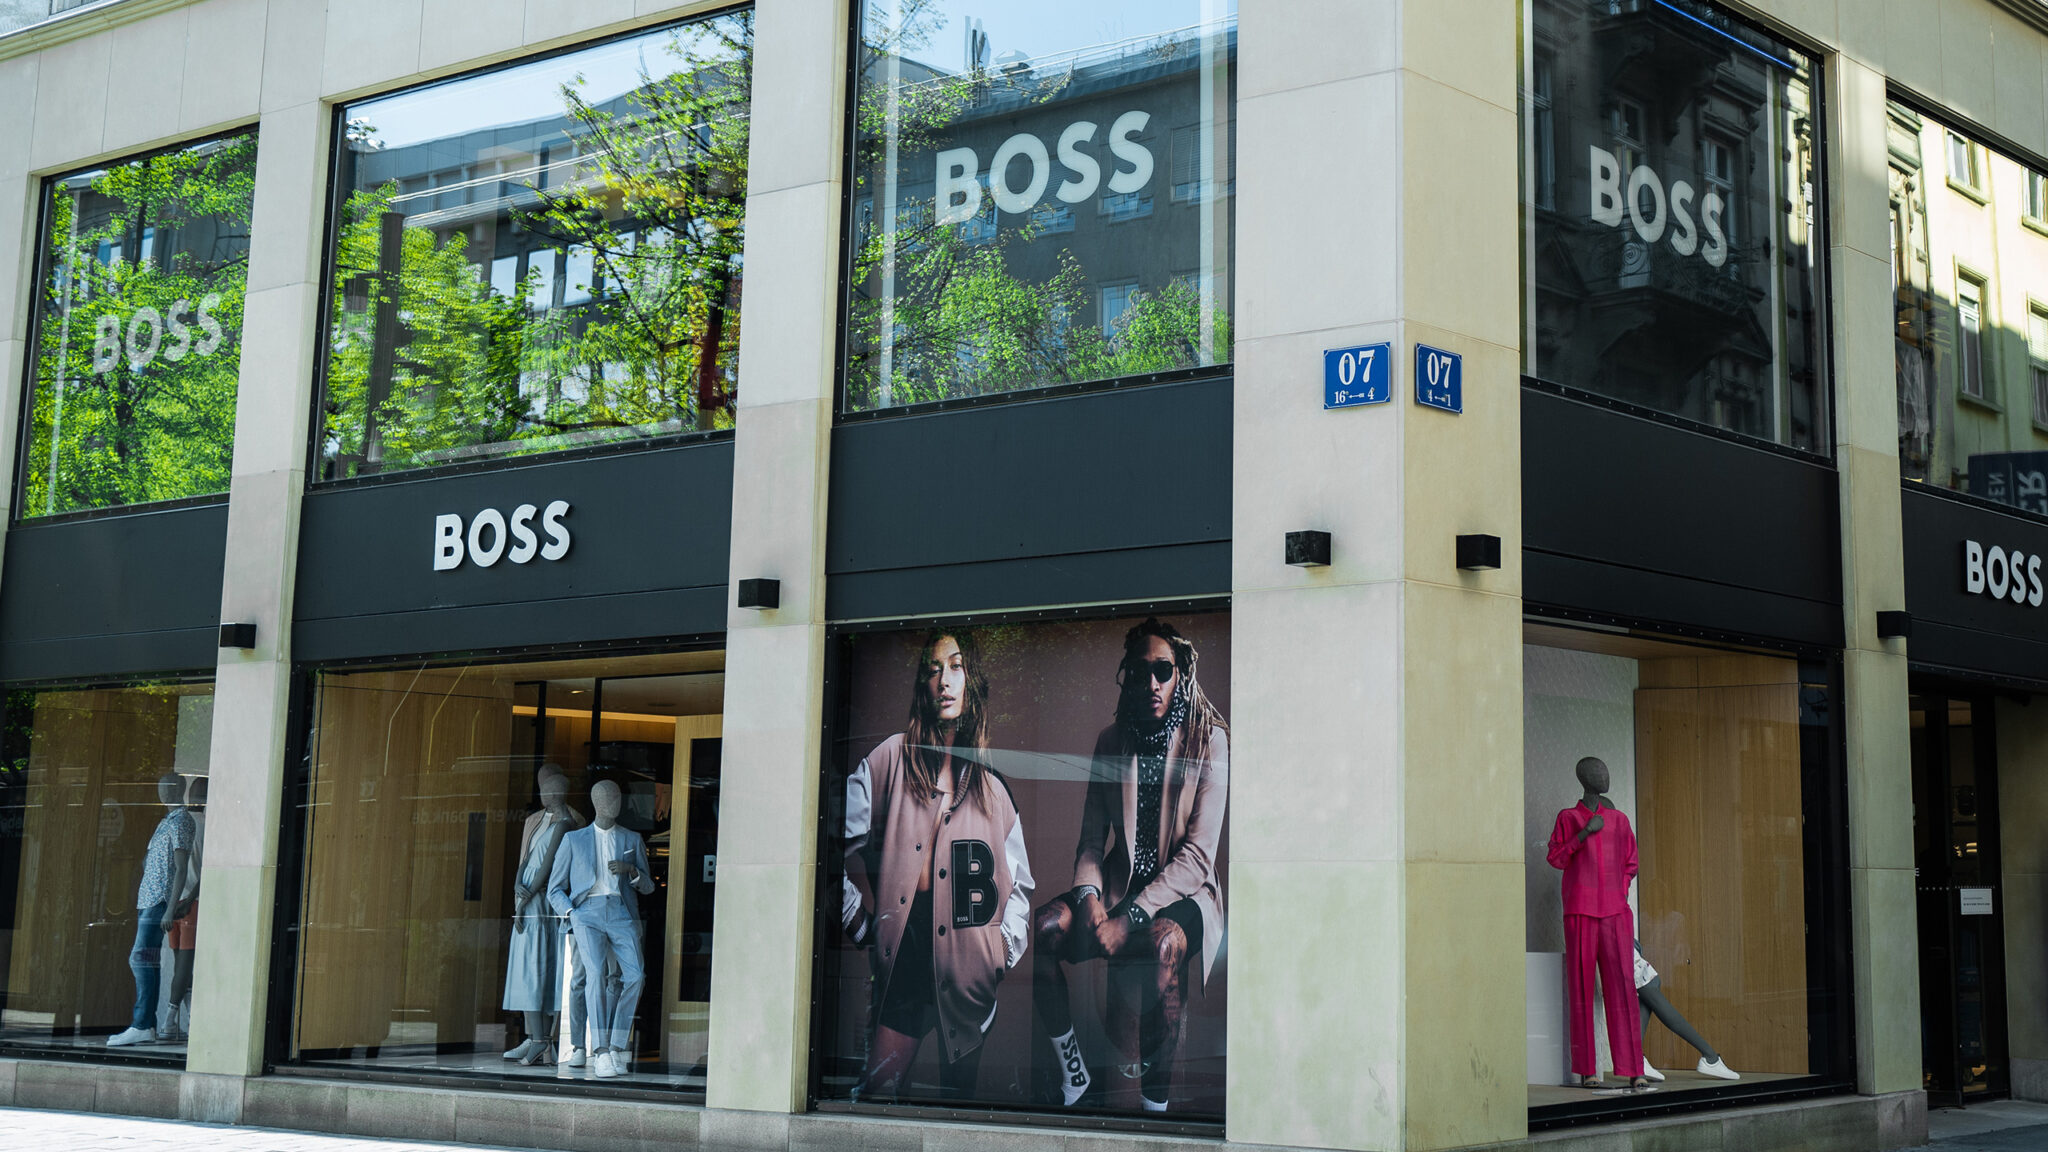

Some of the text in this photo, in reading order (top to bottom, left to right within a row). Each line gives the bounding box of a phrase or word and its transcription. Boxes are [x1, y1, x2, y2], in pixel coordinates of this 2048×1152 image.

[935, 111, 1154, 226] BOSS
[1590, 145, 1728, 267] BOSS
[93, 292, 222, 374] BOSS
[1335, 387, 1375, 404] 16 4
[433, 500, 571, 572] BOSS
[1966, 540, 2044, 607] BOSS
[952, 839, 998, 930] B
[1061, 1034, 1086, 1087] BOSS
